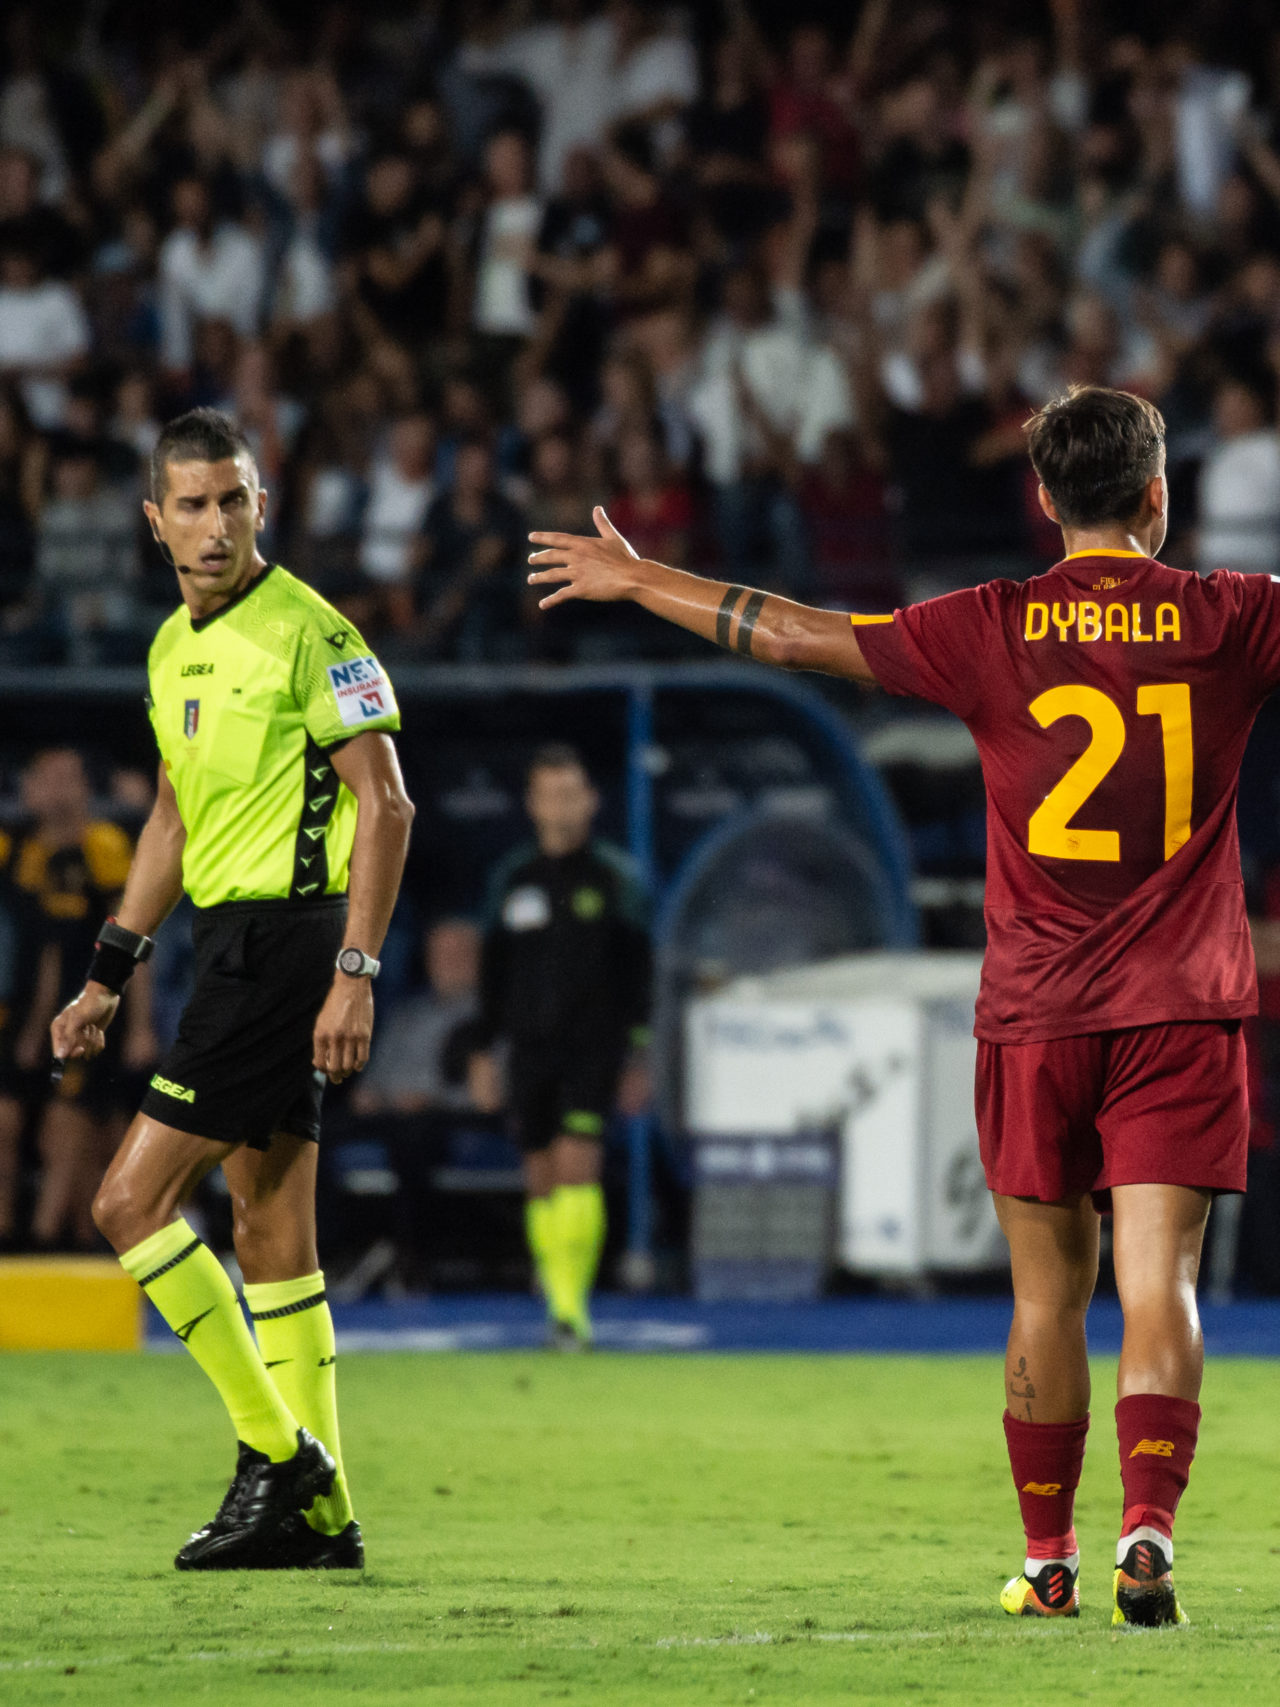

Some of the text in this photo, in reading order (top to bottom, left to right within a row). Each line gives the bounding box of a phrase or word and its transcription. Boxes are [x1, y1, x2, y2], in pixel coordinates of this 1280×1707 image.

[1025, 602, 1181, 642] DYBALA
[181, 663, 214, 677] LEGEA
[331, 659, 379, 688] NET
[1028, 683, 1194, 862] 21
